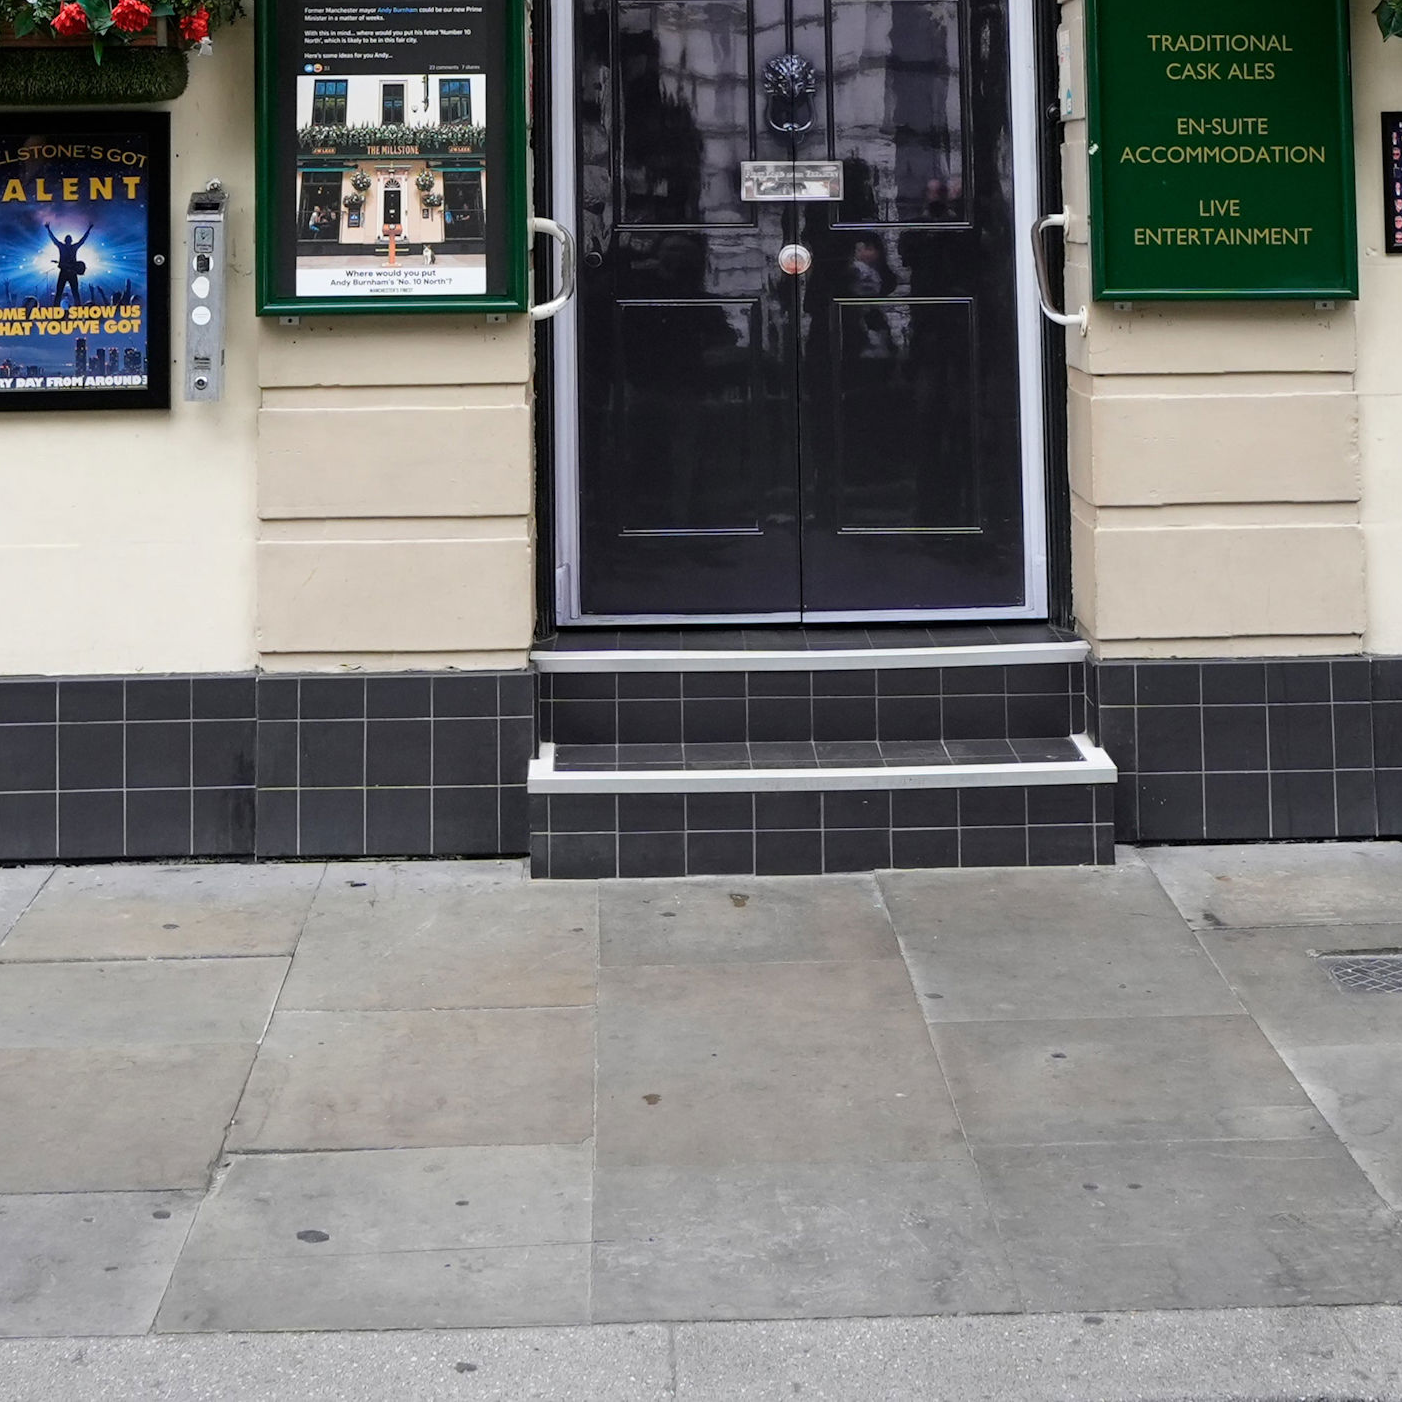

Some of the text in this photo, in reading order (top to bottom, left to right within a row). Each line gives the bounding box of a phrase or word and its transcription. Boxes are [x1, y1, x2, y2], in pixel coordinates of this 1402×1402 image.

[377, 7, 392, 15] Andy
[1147, 34, 1293, 52] TRADITIONAL
[1166, 62, 1275, 81] CASK ALES
[1176, 117, 1269, 135] EN-SUITE
[106, 148, 148, 169] GOT
[367, 145, 420, 155] THE MILLSTONE
[1119, 145, 1326, 164] ACCOMMODATION
[1199, 199, 1241, 217] LIVE
[1134, 227, 1313, 246] ENTERTAINMENT
[403, 271, 420, 279] you
[421, 269, 437, 278] put
[330, 279, 351, 287] Andy
[30, 306, 64, 320] AND
[68, 305, 116, 320] SHOW
[120, 304, 141, 318] US
[36, 320, 99, 335] YOU'VE
[104, 319, 141, 334] GOT
[16, 377, 44, 388] DAY
[46, 376, 83, 387] FROM
[84, 375, 142, 386] AROUND
